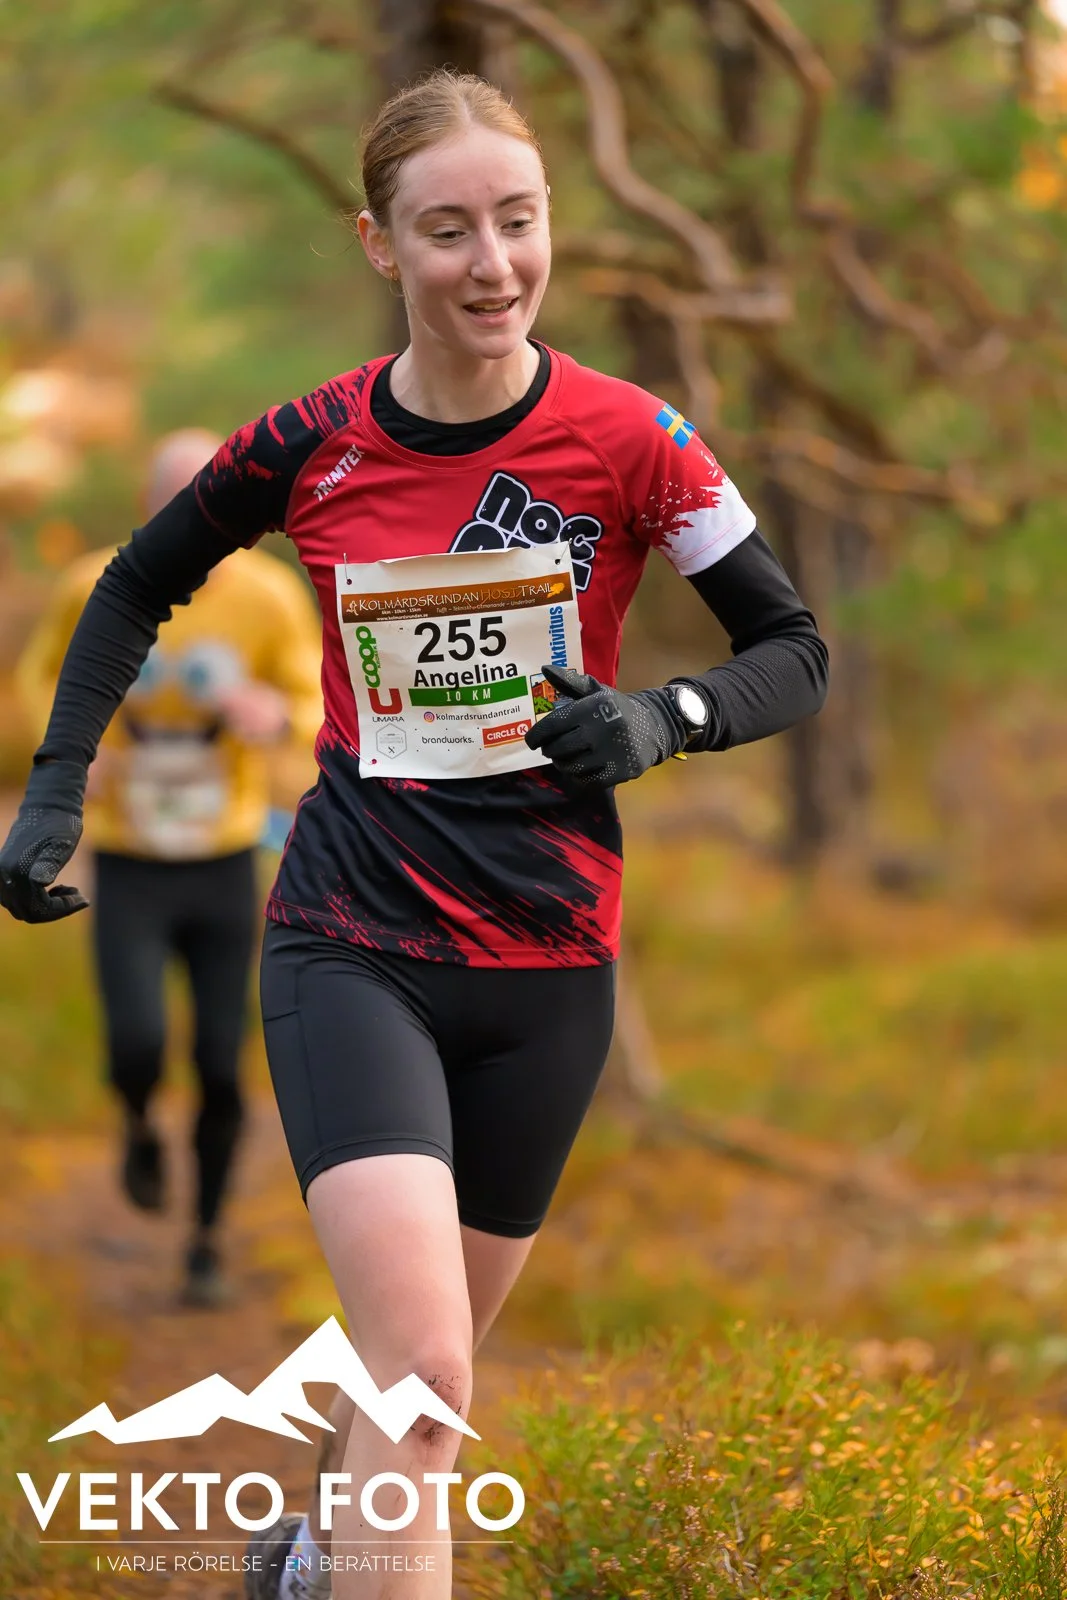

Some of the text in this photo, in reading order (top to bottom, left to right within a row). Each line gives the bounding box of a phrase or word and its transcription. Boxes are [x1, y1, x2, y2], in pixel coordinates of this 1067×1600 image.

[313, 444, 364, 501] TRIMTEX
[414, 616, 507, 664] 255
[548, 605, 568, 667] Aktivitus
[355, 625, 380, 688] coop
[414, 663, 518, 691] Angelina
[446, 688, 491, 702] 10 KM
[436, 705, 521, 721] kolmardsrundantrail
[486, 724, 529, 741] CIRCLE K
